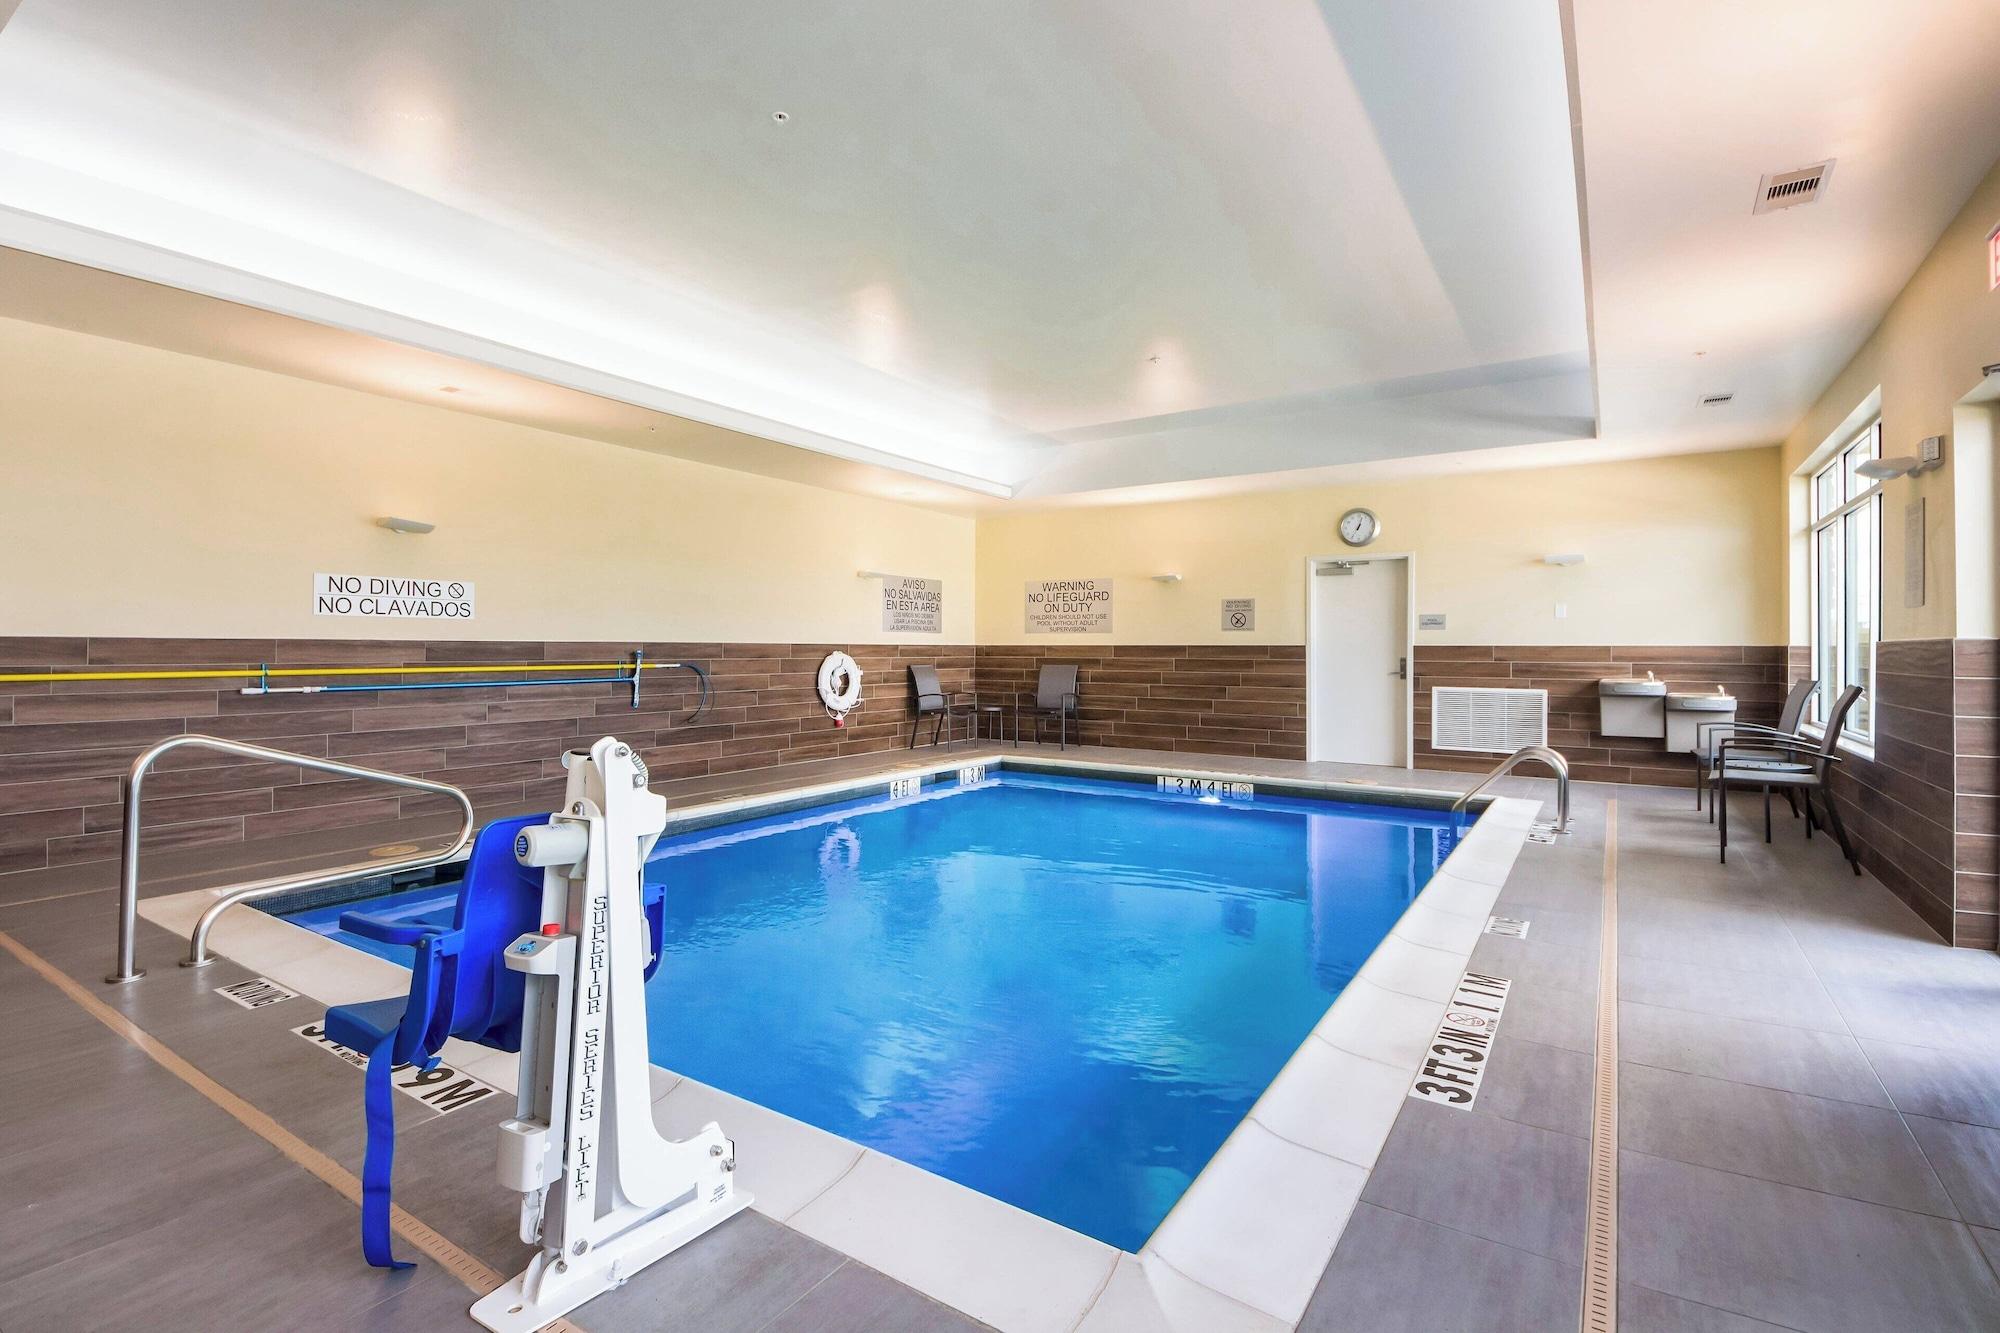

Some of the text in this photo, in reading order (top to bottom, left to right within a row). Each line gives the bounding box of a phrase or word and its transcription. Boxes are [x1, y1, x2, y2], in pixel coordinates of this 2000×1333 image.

[329, 576, 441, 597] NO DIVING
[903, 579, 925, 590] AVISO
[1042, 581, 1094, 592] WARNING
[885, 588, 941, 602] NO SALVAVIDAS
[1029, 591, 1109, 602] NO LIFEGUARD
[319, 597, 470, 617] NO CLAVADOS
[887, 600, 940, 612] EN ESTA AREA
[1044, 603, 1092, 613] ON DUTY
[576, 896, 608, 1200] SUPERIOR SERIES LIFT
